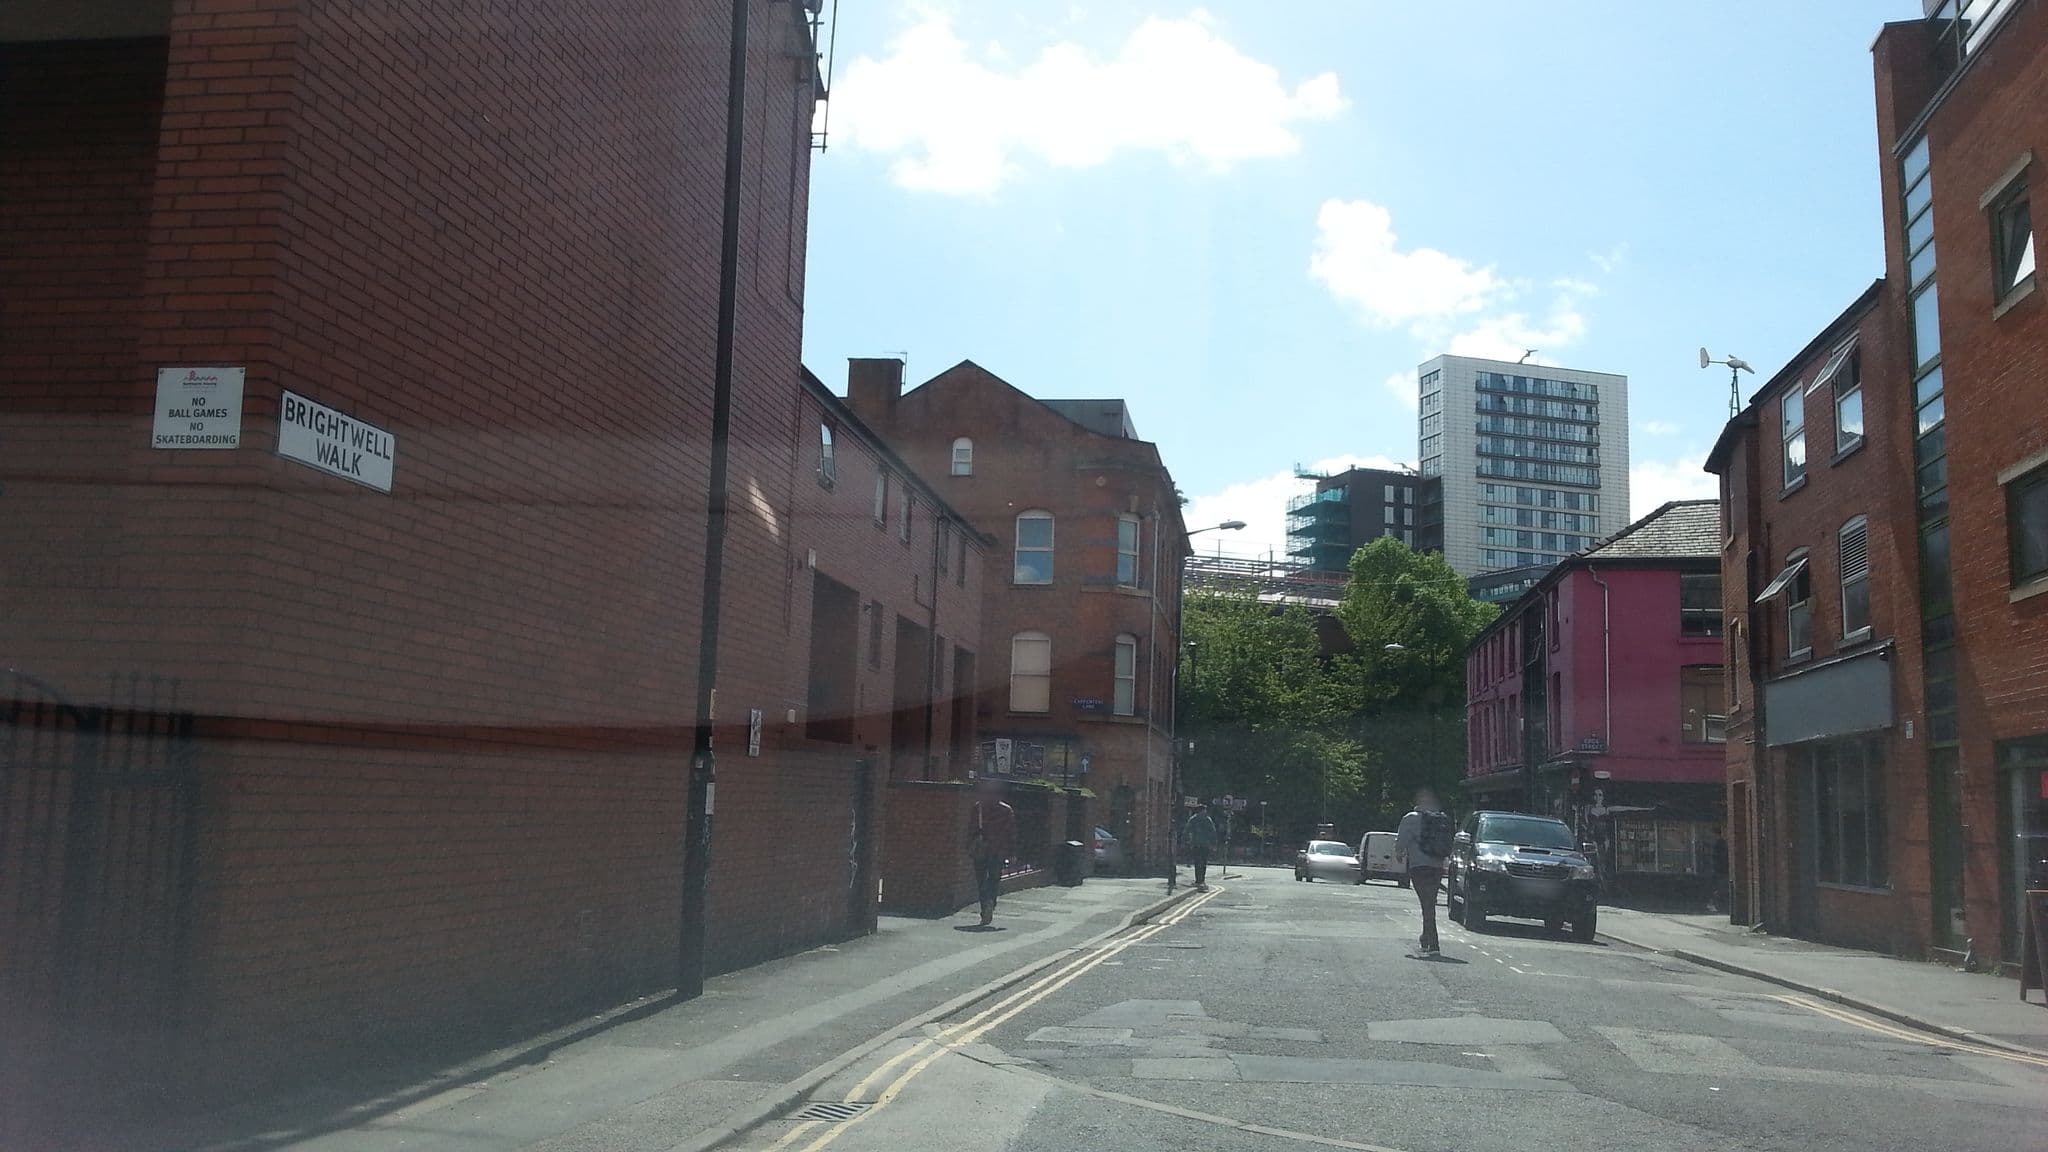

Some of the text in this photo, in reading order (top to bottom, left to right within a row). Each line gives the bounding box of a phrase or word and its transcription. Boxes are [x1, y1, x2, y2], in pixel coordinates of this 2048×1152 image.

[191, 397, 206, 406] NO
[168, 408, 228, 418] BALL GAMES
[189, 422, 204, 431] NO
[285, 397, 391, 460] BRIGHTWELL
[155, 435, 236, 444] SKATEBOARDING
[316, 438, 362, 476] WALK
